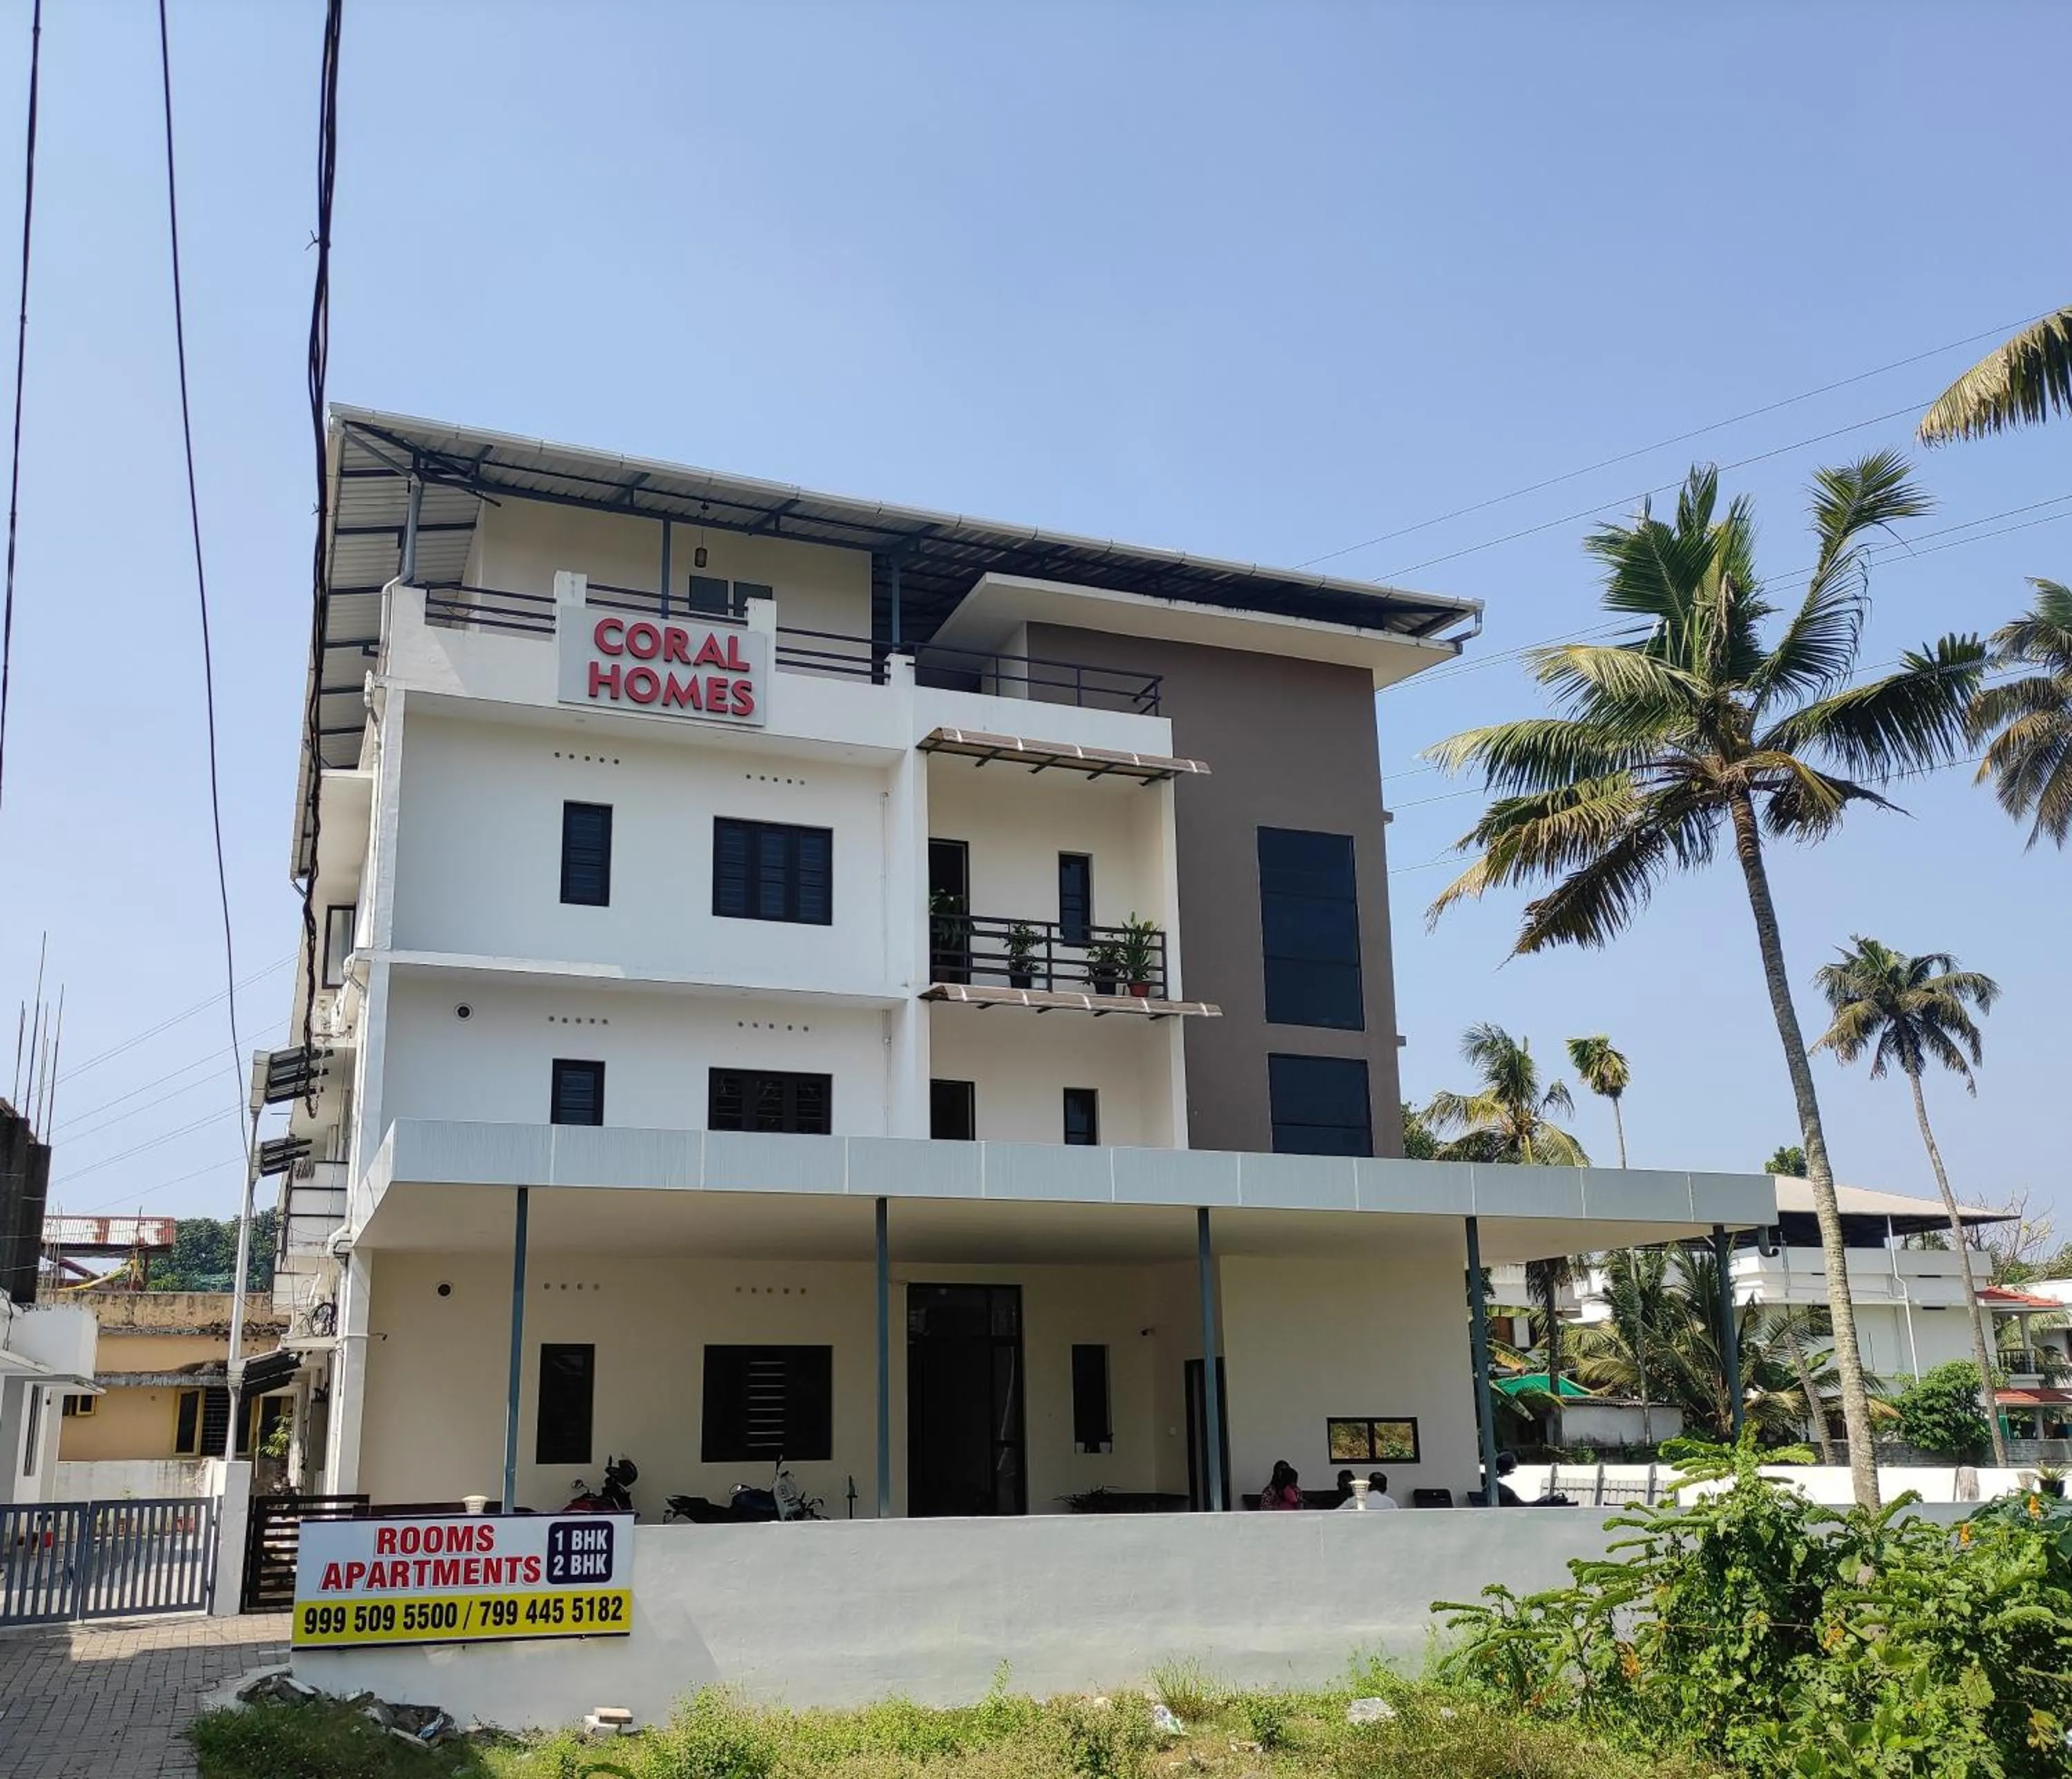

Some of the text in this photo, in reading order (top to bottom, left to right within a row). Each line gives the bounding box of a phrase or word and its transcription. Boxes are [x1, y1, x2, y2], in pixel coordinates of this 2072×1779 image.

[594, 617, 750, 672] CORAL
[588, 661, 755, 716] HOMES
[376, 1524, 495, 1555] ROOMS
[555, 1530, 608, 1551] 1 BHK
[320, 1555, 541, 1591] APARTMENTS
[553, 1554, 607, 1577] 2 BHK
[304, 1595, 623, 1634] 999 509 5500 / 799 445 5182
